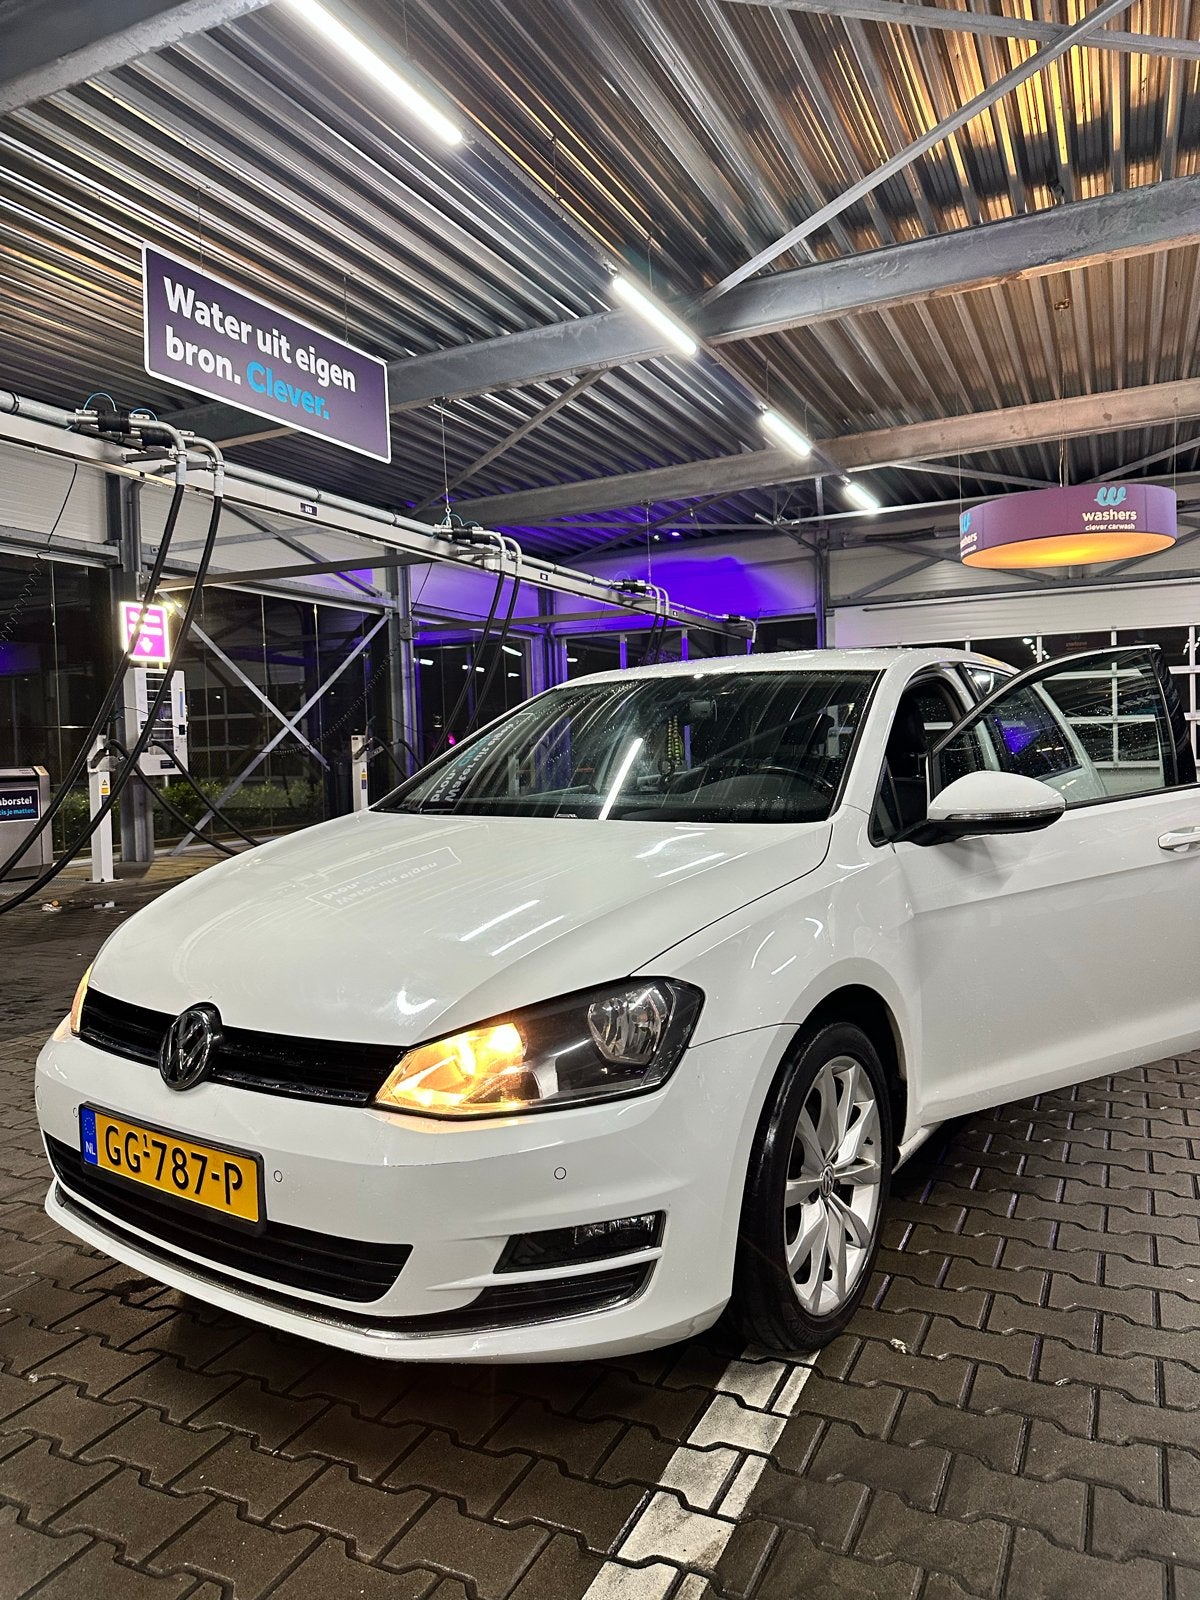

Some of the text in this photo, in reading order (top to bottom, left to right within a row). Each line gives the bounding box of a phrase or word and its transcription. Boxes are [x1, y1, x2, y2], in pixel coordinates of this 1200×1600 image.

[163, 275, 356, 392] Water uit eigen
[165, 325, 330, 420] bron. Clever.
[1082, 509, 1137, 522] washers
[1085, 522, 1135, 531] clever carwash
[85, 1125, 243, 1205] NL GG-787-P
